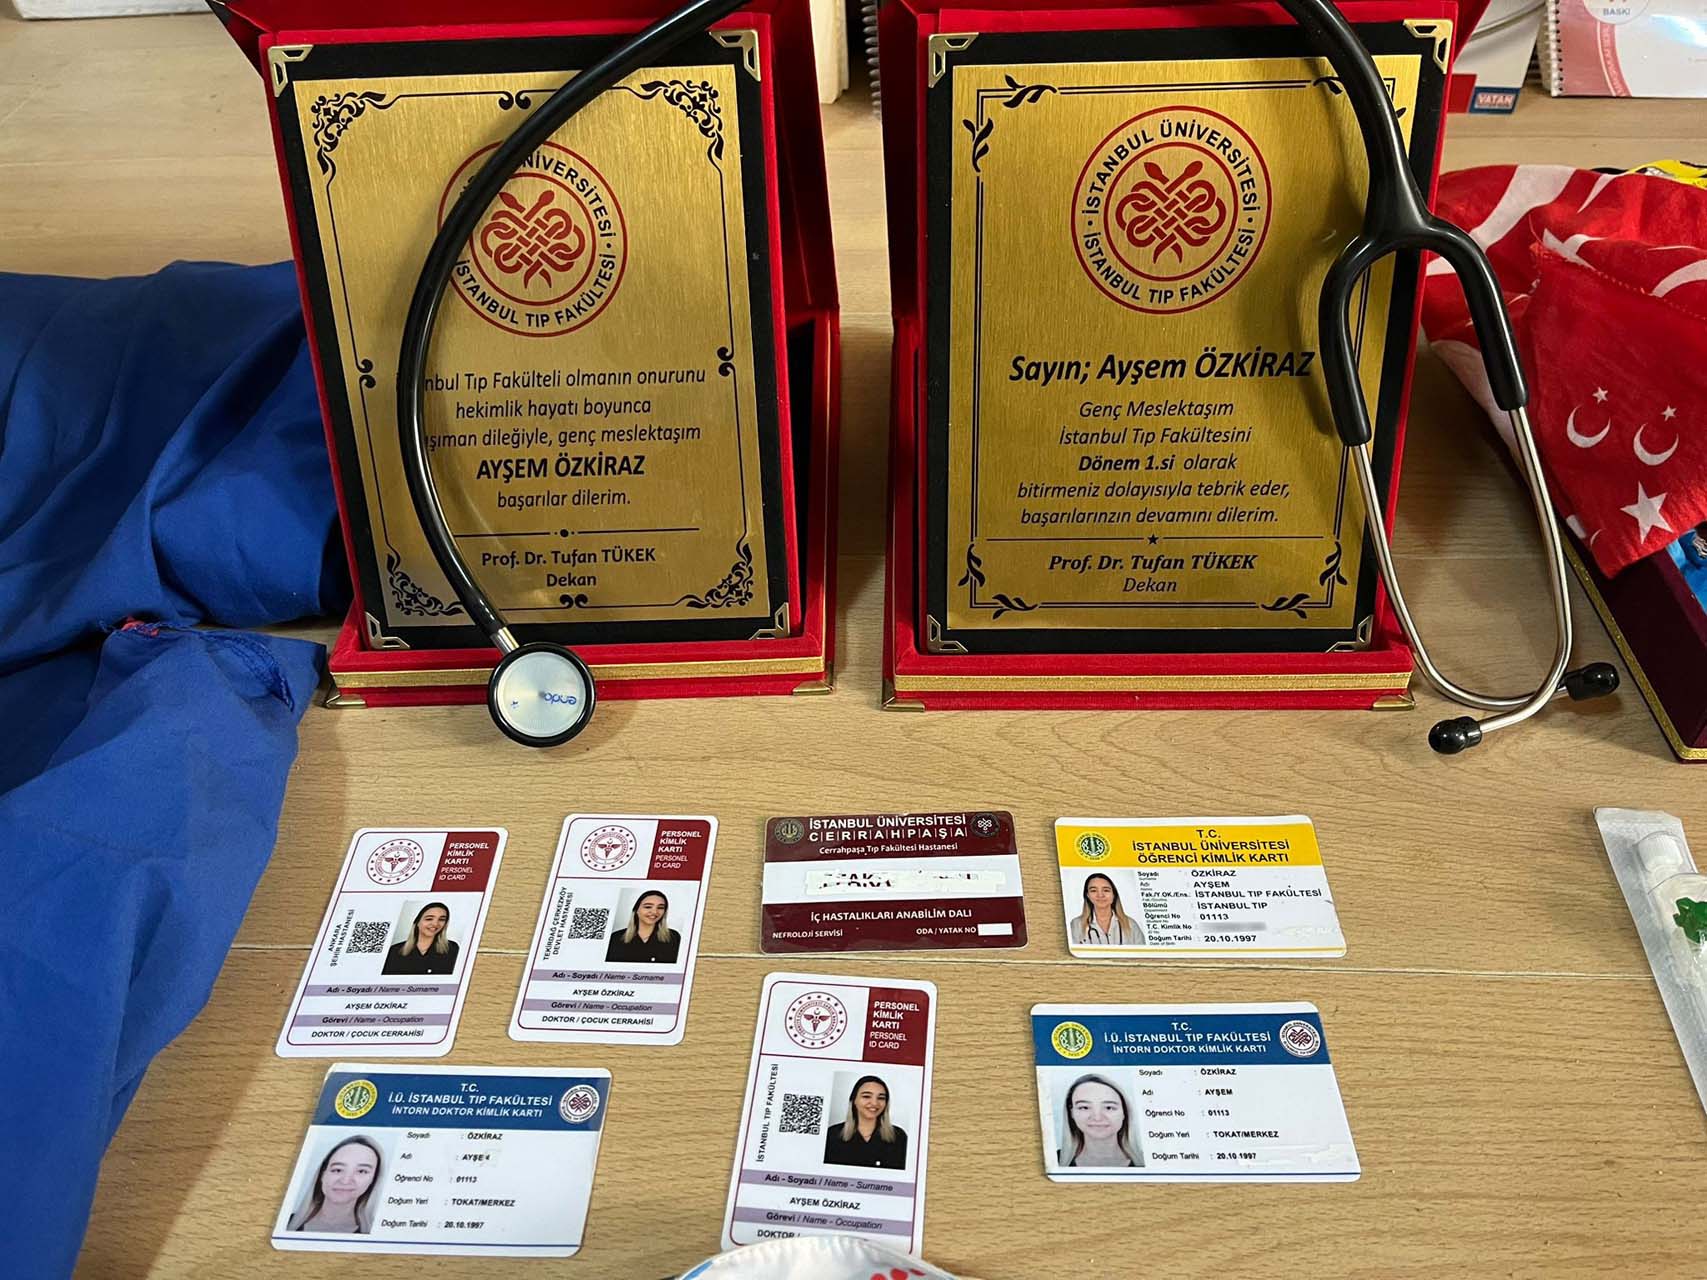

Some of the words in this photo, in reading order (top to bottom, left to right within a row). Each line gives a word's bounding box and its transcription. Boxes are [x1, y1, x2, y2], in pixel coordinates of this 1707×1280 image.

[1478, 95, 1514, 106] VATAN
[1082, 129, 1154, 214] İSTANBUL
[1160, 118, 1260, 212] ÜNİVERSİTESİ
[522, 151, 616, 238] NİVERSİTESİ
[1082, 232, 1140, 300] İSTANBUL
[1148, 289, 1174, 304] TIP
[1180, 228, 1256, 302] FAKÜLTESİ
[456, 259, 519, 324] İSTANBUL
[525, 314, 550, 328] TIP
[555, 252, 617, 325] FAKÜLTESİ
[1009, 356, 1090, 386] Sayın;
[1096, 354, 1186, 385] Ayşem
[1195, 346, 1315, 378] ÖZKİRAZ
[464, 373, 488, 394] Tıp
[493, 370, 561, 389] Fakülteli
[566, 368, 632, 387] olmanın
[638, 369, 706, 384] onurunu
[456, 400, 522, 419] hekimlik
[528, 400, 578, 420] hayatı
[584, 398, 651, 418] boyunca
[1080, 401, 1122, 420] Genç
[1126, 400, 1234, 419] Meslektaşım
[482, 427, 553, 448] dileğiyle,
[558, 430, 596, 448] genç
[601, 424, 700, 444] meslektaşım
[1060, 426, 1128, 444] İstanbul
[1132, 428, 1156, 447] Tıp
[1160, 426, 1252, 444] Fakültesini
[476, 458, 548, 484] AYŞEM
[554, 452, 646, 477] ÖZKİRAZ
[1078, 456, 1140, 471] Dönem
[1144, 454, 1176, 470] 1.si
[1184, 453, 1238, 470] olarak
[1017, 482, 1100, 498] bitirmeniz
[1104, 481, 1192, 500] dolayısıyla
[1197, 480, 1246, 496] tebrik
[1250, 480, 1290, 498] eder,
[498, 491, 568, 511] başarılar
[572, 489, 631, 506] dilerim.
[1021, 508, 1131, 527] başarılarınzın
[1136, 507, 1212, 522] devamını
[1216, 506, 1278, 522] dilerim.
[482, 551, 520, 569] Prof.
[524, 552, 546, 564] Dr.
[551, 549, 597, 567] Tufan
[602, 546, 656, 562] TÜKEK
[1048, 554, 1092, 574] Prof.
[1097, 555, 1124, 570] Dr.
[1131, 554, 1184, 574] Tufan
[1192, 552, 1258, 570] TÜKEK
[546, 573, 596, 587] Dekan
[1122, 577, 1177, 592] Dekan
[809, 818, 874, 830] İSTANBUL
[876, 814, 966, 828] ÜNİVERSİTESİ
[1196, 829, 1221, 838] T.C.
[819, 846, 865, 855] Cerrahpaşa
[866, 846, 879, 854] Tıp
[880, 844, 917, 852] Fakültesi
[918, 842, 958, 850] Hastanesi
[1132, 840, 1197, 851] İSTANBUL
[1200, 839, 1290, 850] ÜNİVERSİTESİ
[1138, 852, 1198, 863] ÖĞRENCİ
[1201, 852, 1246, 862] KİMLİK
[1250, 853, 1289, 862] KARTI
[1191, 869, 1237, 877] ÖZKİRAZ
[1194, 889, 1246, 898] İSTANBUL
[1265, 886, 1321, 897] FAKÜLTESİ
[1198, 901, 1250, 910] İSTANBUL
[823, 912, 894, 921] HASTALIKLARI
[896, 908, 946, 920] ANABİLİM
[949, 909, 972, 918] DALI
[772, 930, 814, 938] NEFROLOJİ
[815, 929, 843, 938] SERVİSİ
[601, 988, 635, 997] ÖZKİRAZ
[874, 1001, 920, 1012] PERSONEL
[873, 1010, 904, 1020] KİMLİK
[872, 1020, 900, 1029] KARTI
[1171, 1022, 1192, 1031] T.C.
[870, 1031, 907, 1040] PERSONEL
[1125, 1032, 1183, 1043] İSTANBUL
[1185, 1033, 1203, 1042] TIP
[1207, 1031, 1271, 1042] FAKÜLTESİ
[878, 1041, 900, 1049] CARD
[1113, 1044, 1151, 1054] İNTORN
[1154, 1045, 1196, 1053] DOKTOR
[1199, 1044, 1233, 1053] KİMLİK
[461, 1083, 479, 1092] T.C.
[408, 1092, 465, 1104] İSTANBUL
[469, 1095, 486, 1104] TIP
[489, 1095, 553, 1106] FAKÜLTESİ
[392, 1105, 429, 1115] İNTORN
[432, 1107, 474, 1116] DOKTOR
[476, 1107, 509, 1117] KİMLİK
[512, 1109, 543, 1118] KARTI
[756, 1122, 770, 1162] İSTANBUL
[766, 1064, 778, 1105] FAKÜLTESİ
[467, 1132, 503, 1140] ÖZKİRAZ
[788, 1175, 817, 1185] Soyadı
[452, 1198, 516, 1207] TOKAT/MERKEZ
[790, 1197, 820, 1206] AYŞEM
[822, 1199, 861, 1210] ÖZKİRAZ
